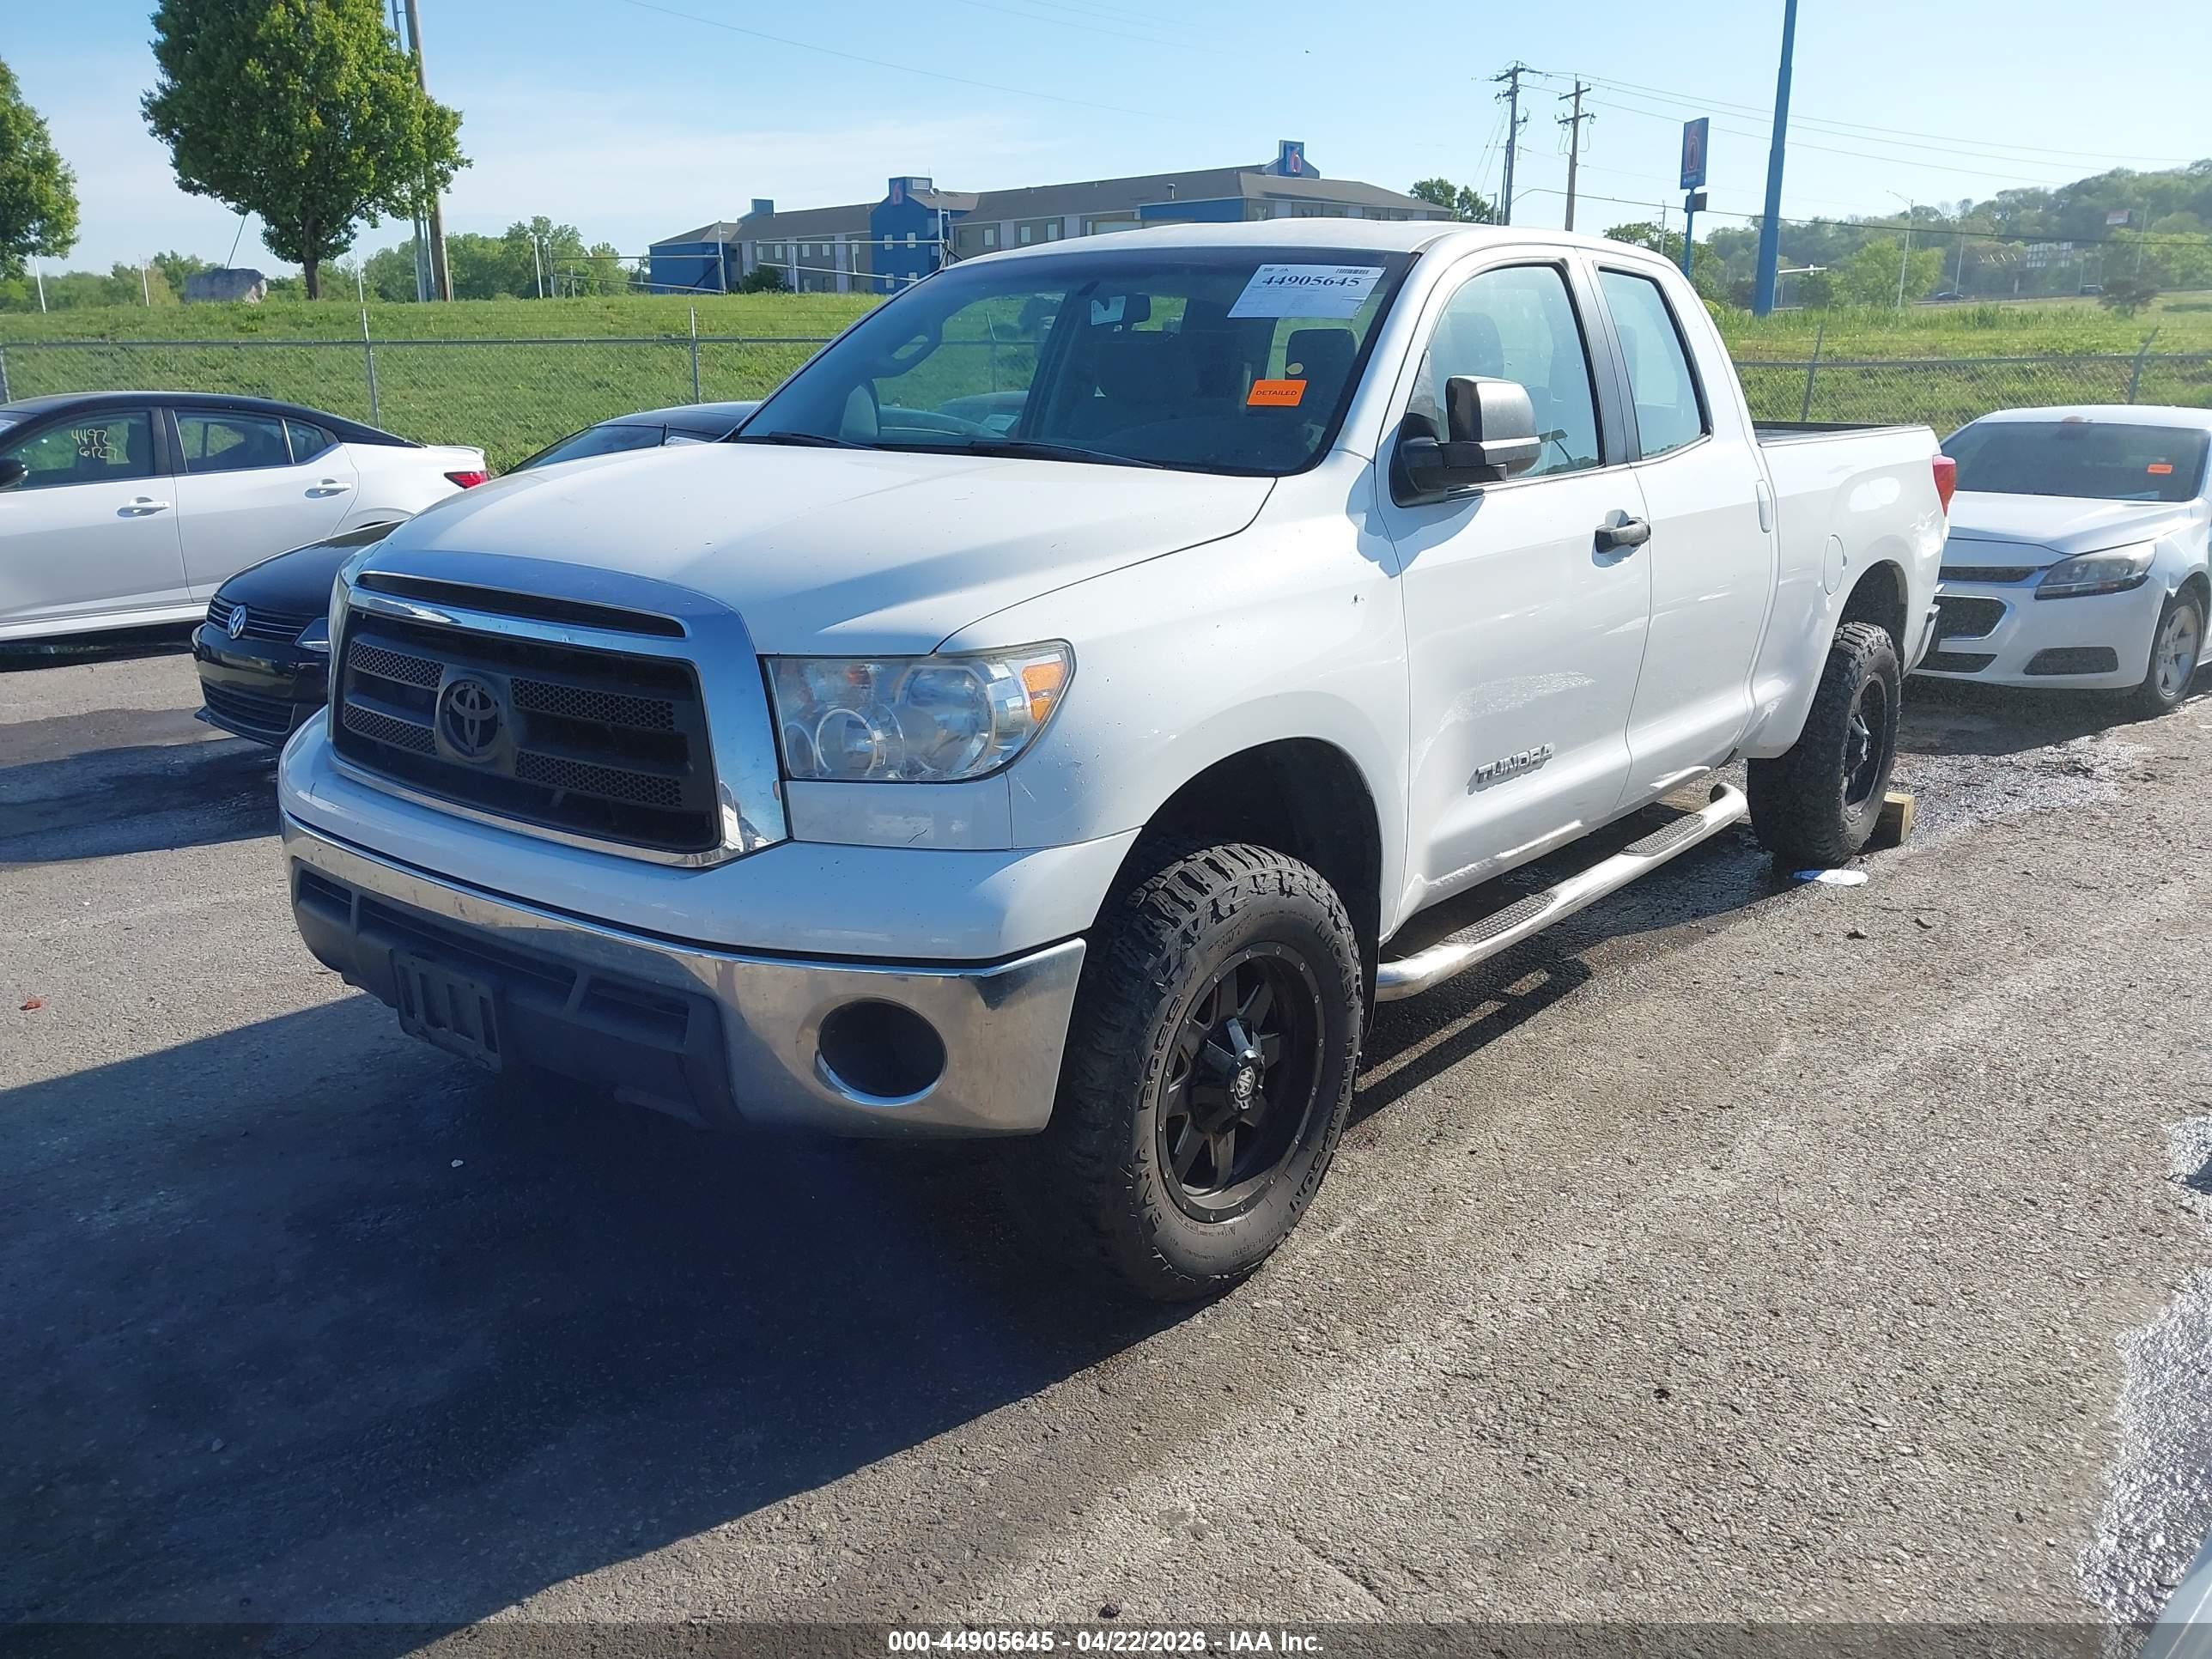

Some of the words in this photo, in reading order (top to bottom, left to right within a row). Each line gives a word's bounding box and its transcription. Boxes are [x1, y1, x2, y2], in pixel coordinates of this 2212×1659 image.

[1261, 275, 1362, 287] 44905645
[71, 428, 112, 446] 4492
[1465, 742, 1553, 795] TUNDRA
[1139, 994, 1183, 1111] BOSS
